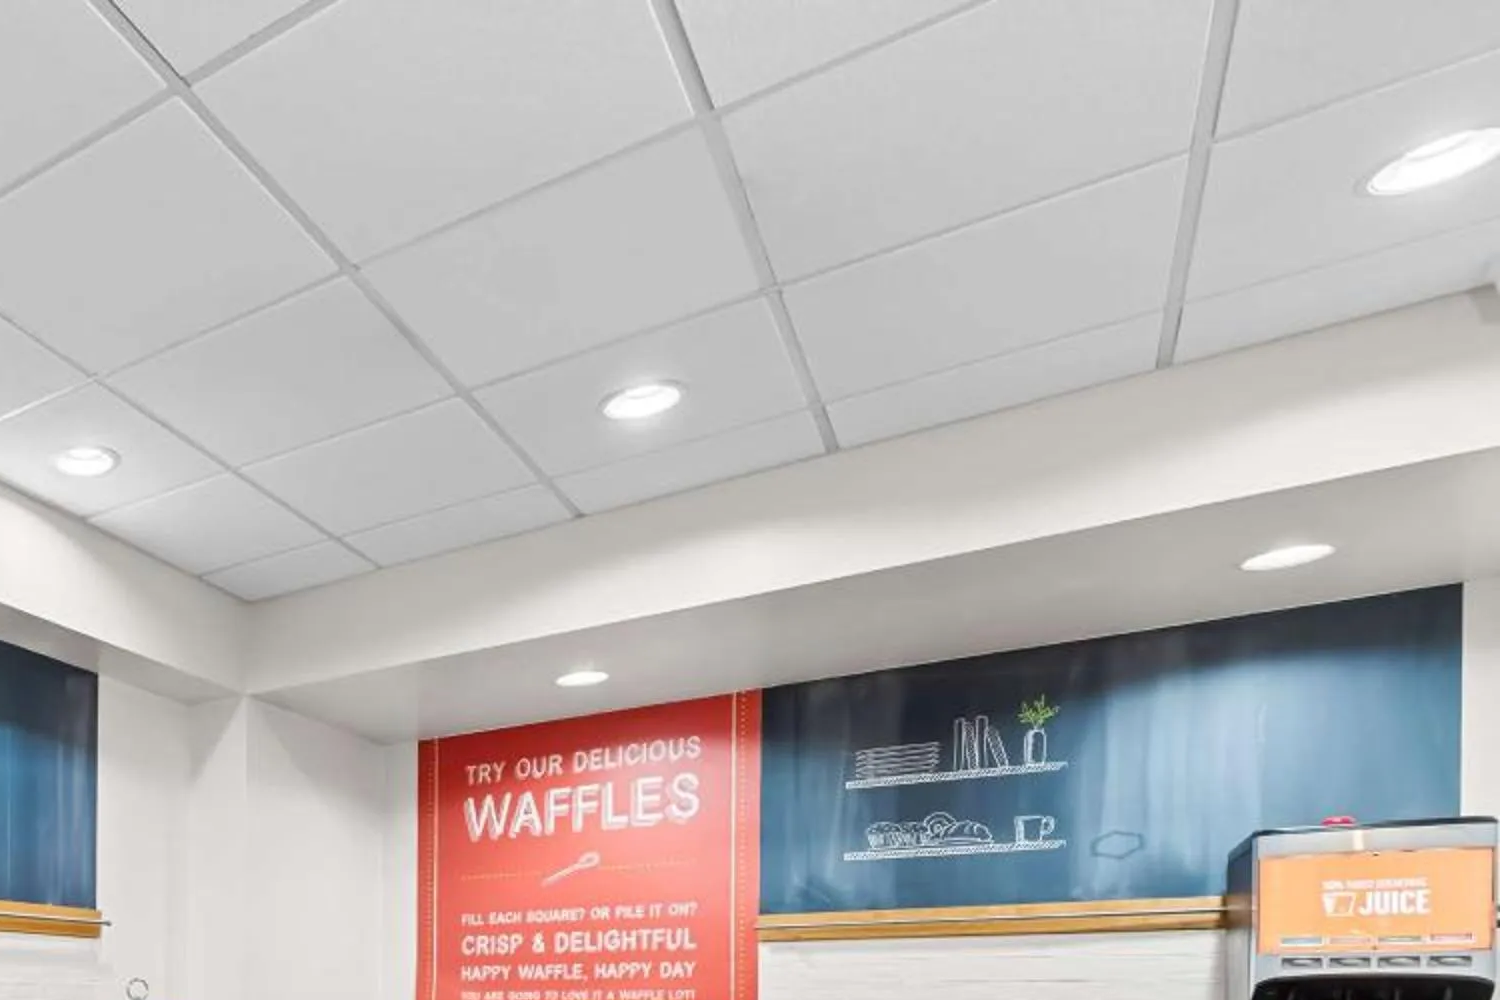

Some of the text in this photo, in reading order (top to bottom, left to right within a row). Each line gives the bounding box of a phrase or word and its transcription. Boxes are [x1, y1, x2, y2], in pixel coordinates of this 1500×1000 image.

[466, 735, 701, 786] TRY OUR DELICIOUS
[463, 772, 700, 843] WAFFLES
[461, 913, 485, 926] FILL
[489, 910, 521, 924] EACH
[590, 906, 610, 920] OR
[615, 904, 645, 919] PILE
[649, 903, 663, 919] IT
[1358, 889, 1431, 916] JUICE
[461, 928, 698, 956] CRISP & DELIGHTFUL
[461, 961, 695, 983] HAPPY WAFFLE, HAPPY DAY
[606, 990, 615, 1000] A
